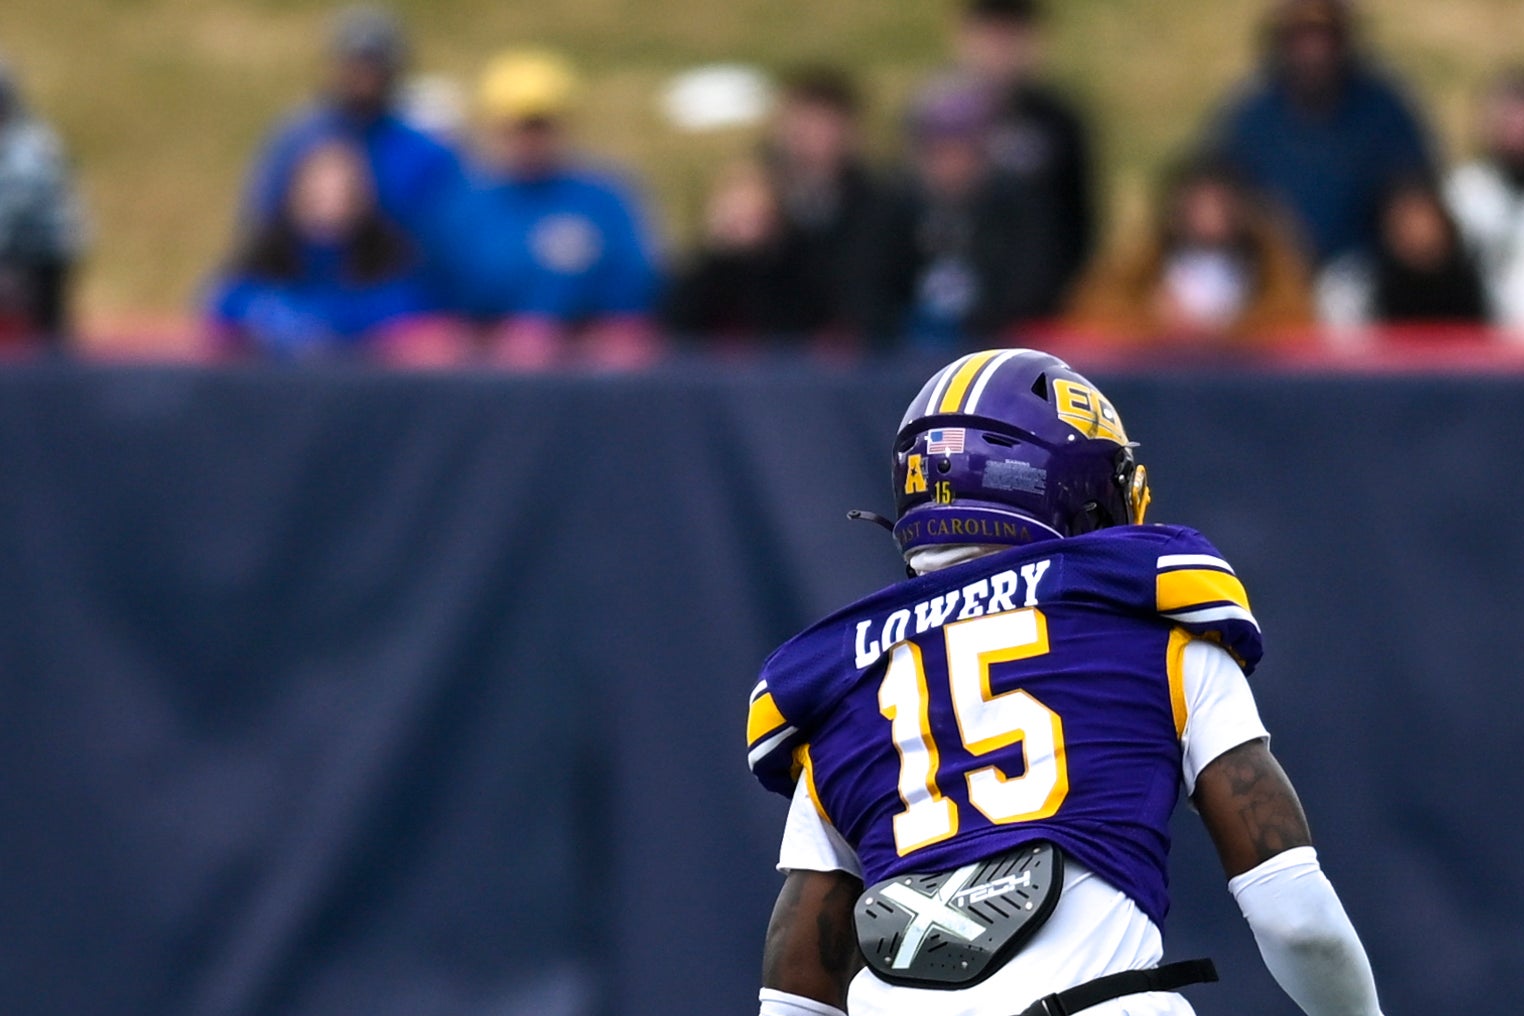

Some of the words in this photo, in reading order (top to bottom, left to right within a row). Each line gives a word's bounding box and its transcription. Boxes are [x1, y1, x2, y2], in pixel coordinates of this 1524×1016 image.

[935, 481, 951, 504] 15
[927, 518, 1034, 542] CAROLINA
[854, 559, 1052, 670] LOWERY
[878, 605, 1070, 858] 15
